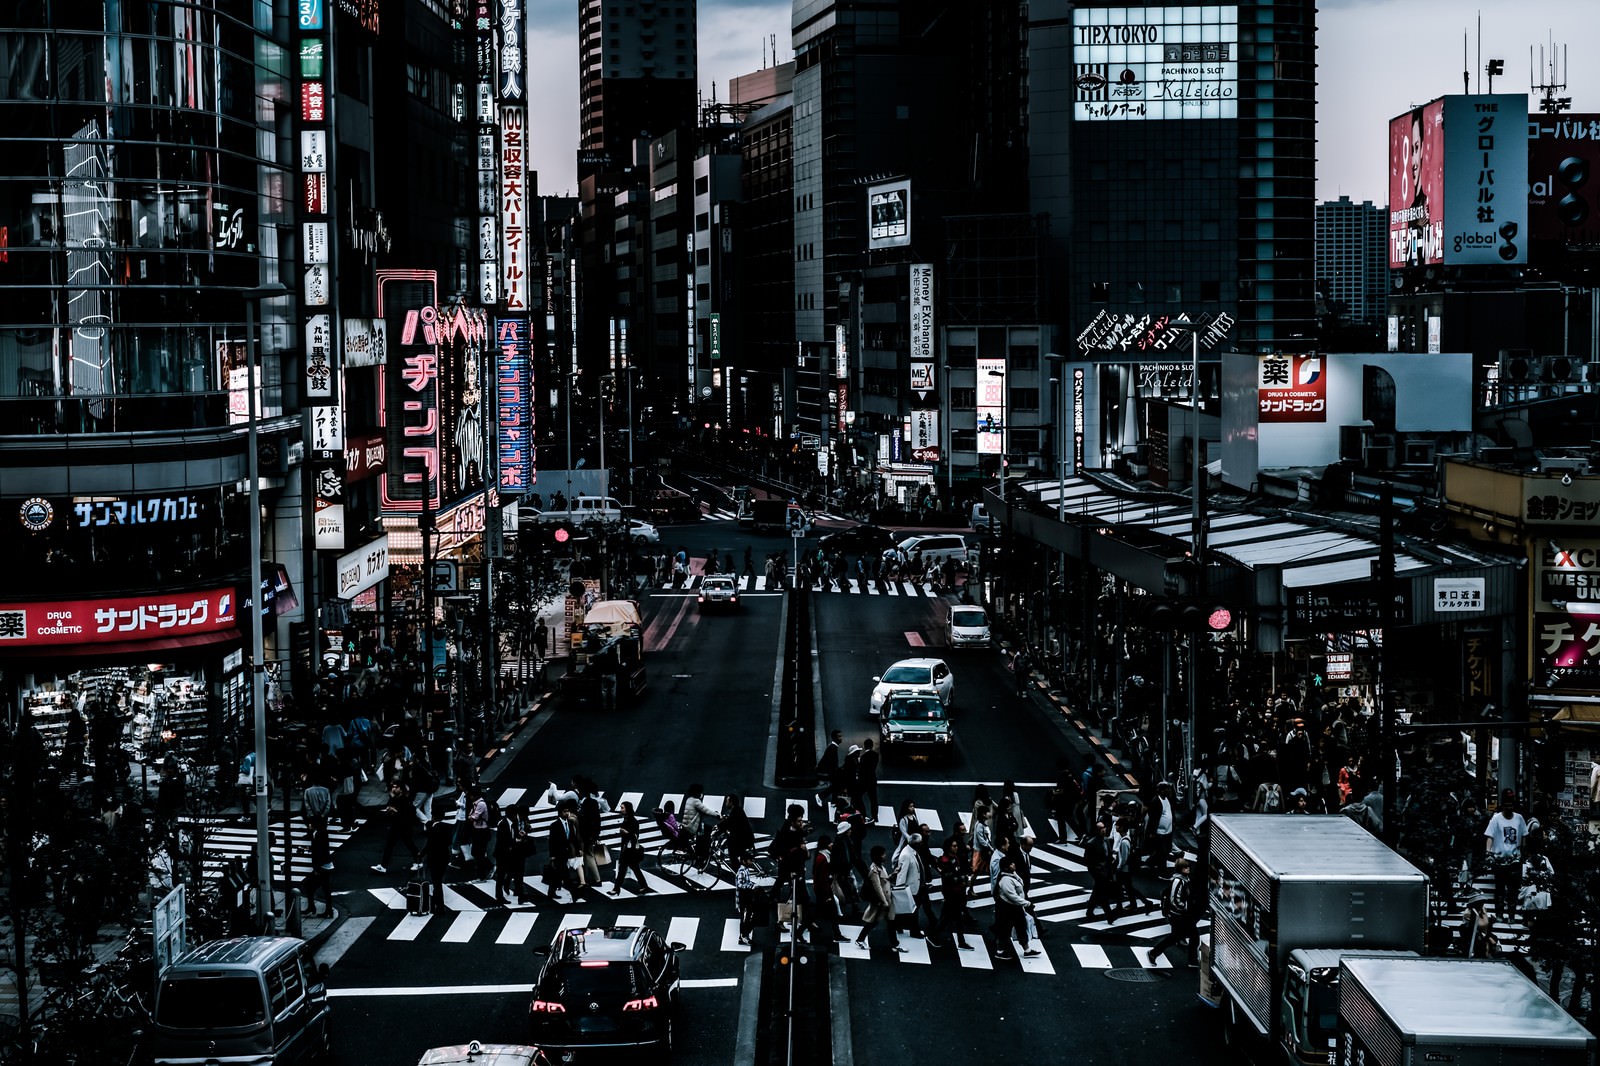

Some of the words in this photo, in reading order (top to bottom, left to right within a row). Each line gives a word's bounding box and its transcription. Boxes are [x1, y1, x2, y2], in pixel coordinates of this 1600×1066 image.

[1114, 26, 1157, 44] TOKYO
[309, 83, 323, 120] 美容室
[1112, 89, 1142, 97] バーミヤン
[1153, 78, 1233, 100] Kaleido
[1474, 104, 1498, 112] THE
[481, 138, 491, 168] 補聴器
[1478, 116, 1494, 223] グローバル社
[502, 108, 523, 307] 100名収容大パーティールーム
[1454, 232, 1497, 252] global
[922, 268, 931, 301] Money
[1078, 314, 1118, 356] Kaleido
[1137, 314, 1169, 350] ジョナサン
[1200, 313, 1235, 350] TIPNESS
[1136, 371, 1201, 389] Kaleid
[1263, 359, 1289, 385] 薬
[401, 306, 437, 483] パチンコ
[500, 322, 523, 485] パチンコジャンボ
[1260, 399, 1324, 412] サンドラッグ
[316, 408, 327, 448] ノアール
[922, 450, 938, 459] 300m
[74, 496, 199, 527] サンマルクカフェ
[367, 548, 385, 576] カラオケ
[1438, 591, 1481, 600] 東口近道
[0, 612, 25, 637] 薬
[47, 611, 72, 620] DRUG
[57, 619, 63, 627] &
[94, 599, 209, 633] サンドラッグ
[37, 626, 82, 635] COSMETIC
[1466, 637, 1483, 697] チケット
[1541, 657, 1600, 665] TICK
